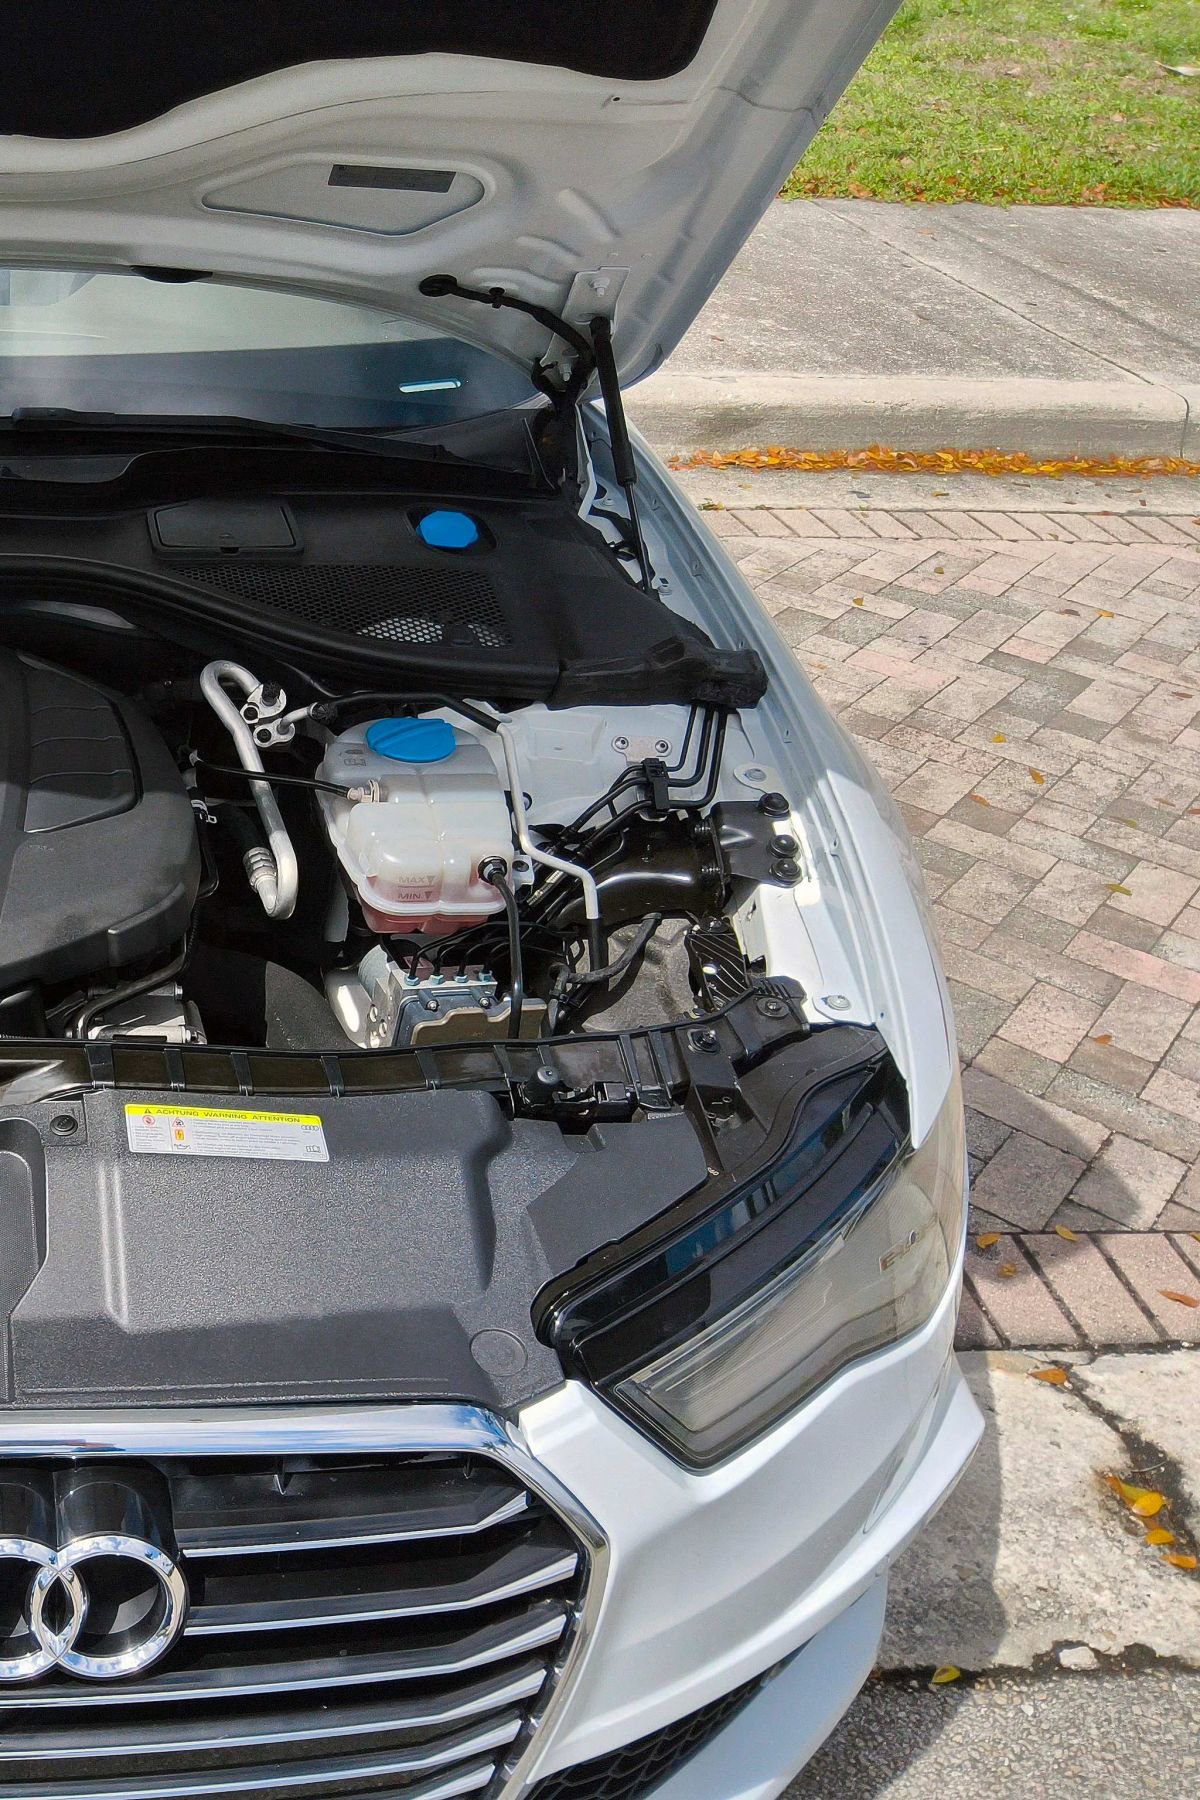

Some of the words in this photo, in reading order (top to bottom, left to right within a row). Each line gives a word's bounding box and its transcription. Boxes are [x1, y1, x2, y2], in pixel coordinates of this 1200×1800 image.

[398, 876, 425, 884] MAX
[156, 1109, 199, 1117] ACHTUNG
[204, 1112, 247, 1120] WARNING
[252, 1115, 301, 1123] ATTENTION
